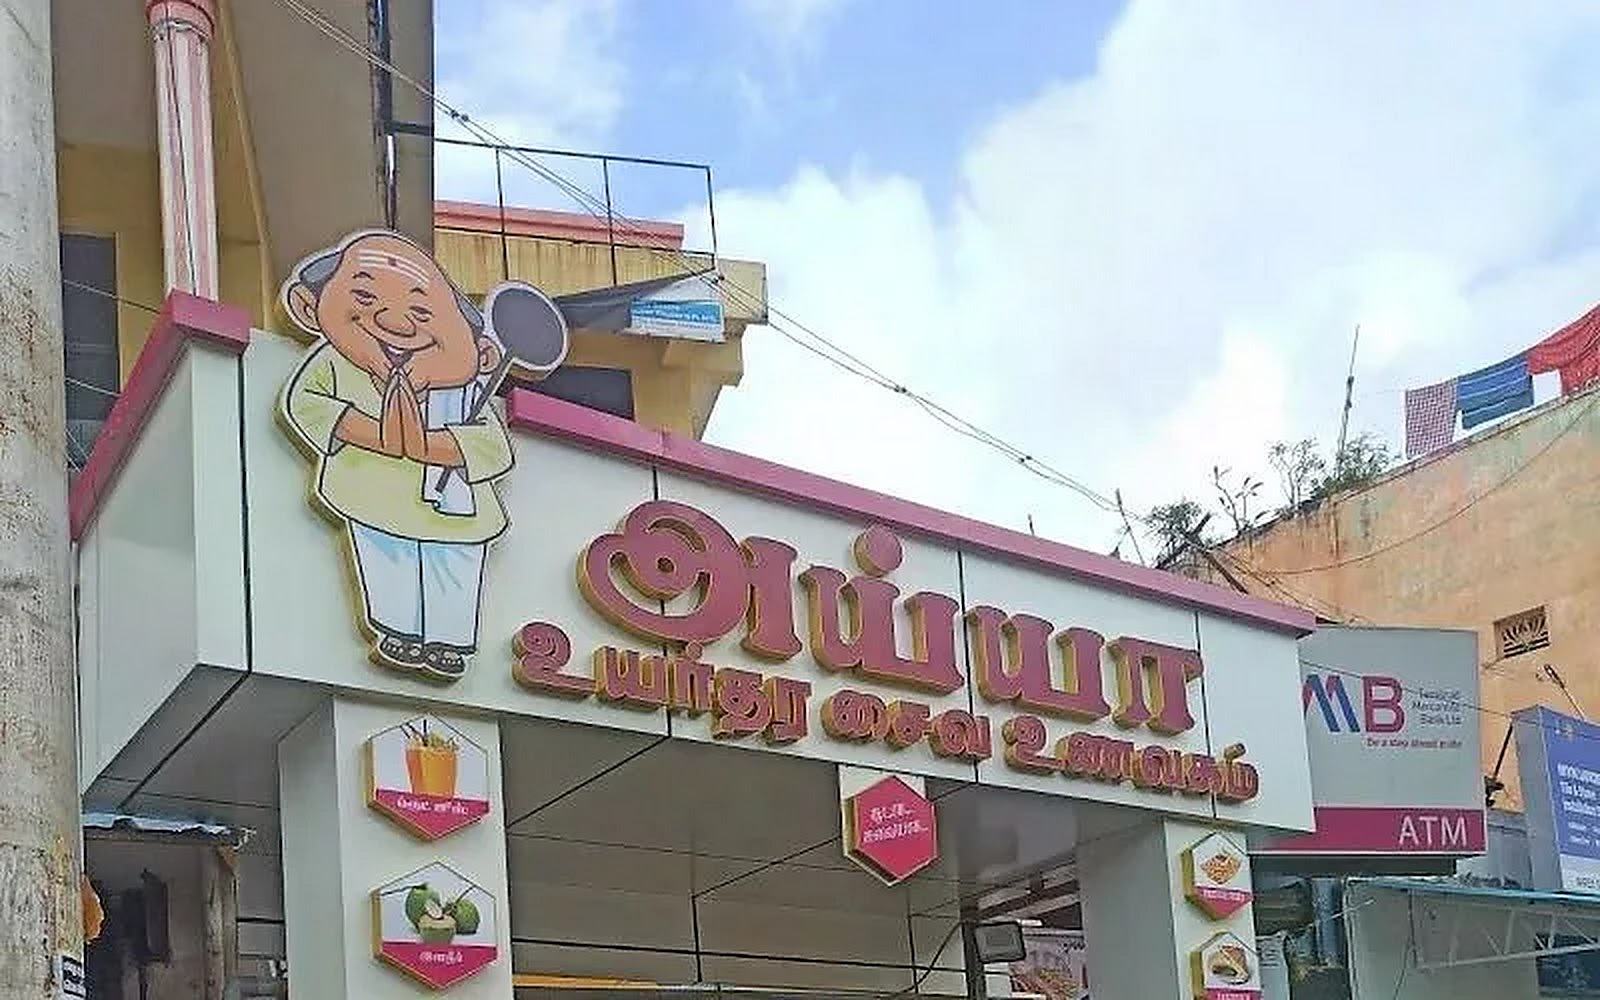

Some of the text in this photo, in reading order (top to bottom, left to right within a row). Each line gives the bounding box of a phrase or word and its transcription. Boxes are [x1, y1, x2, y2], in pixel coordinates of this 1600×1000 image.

[577, 499, 1204, 736] அய்யா
[512, 622, 1260, 804] உயர்தர சைவ உணவகம்
[1398, 816, 1467, 846] ATM
